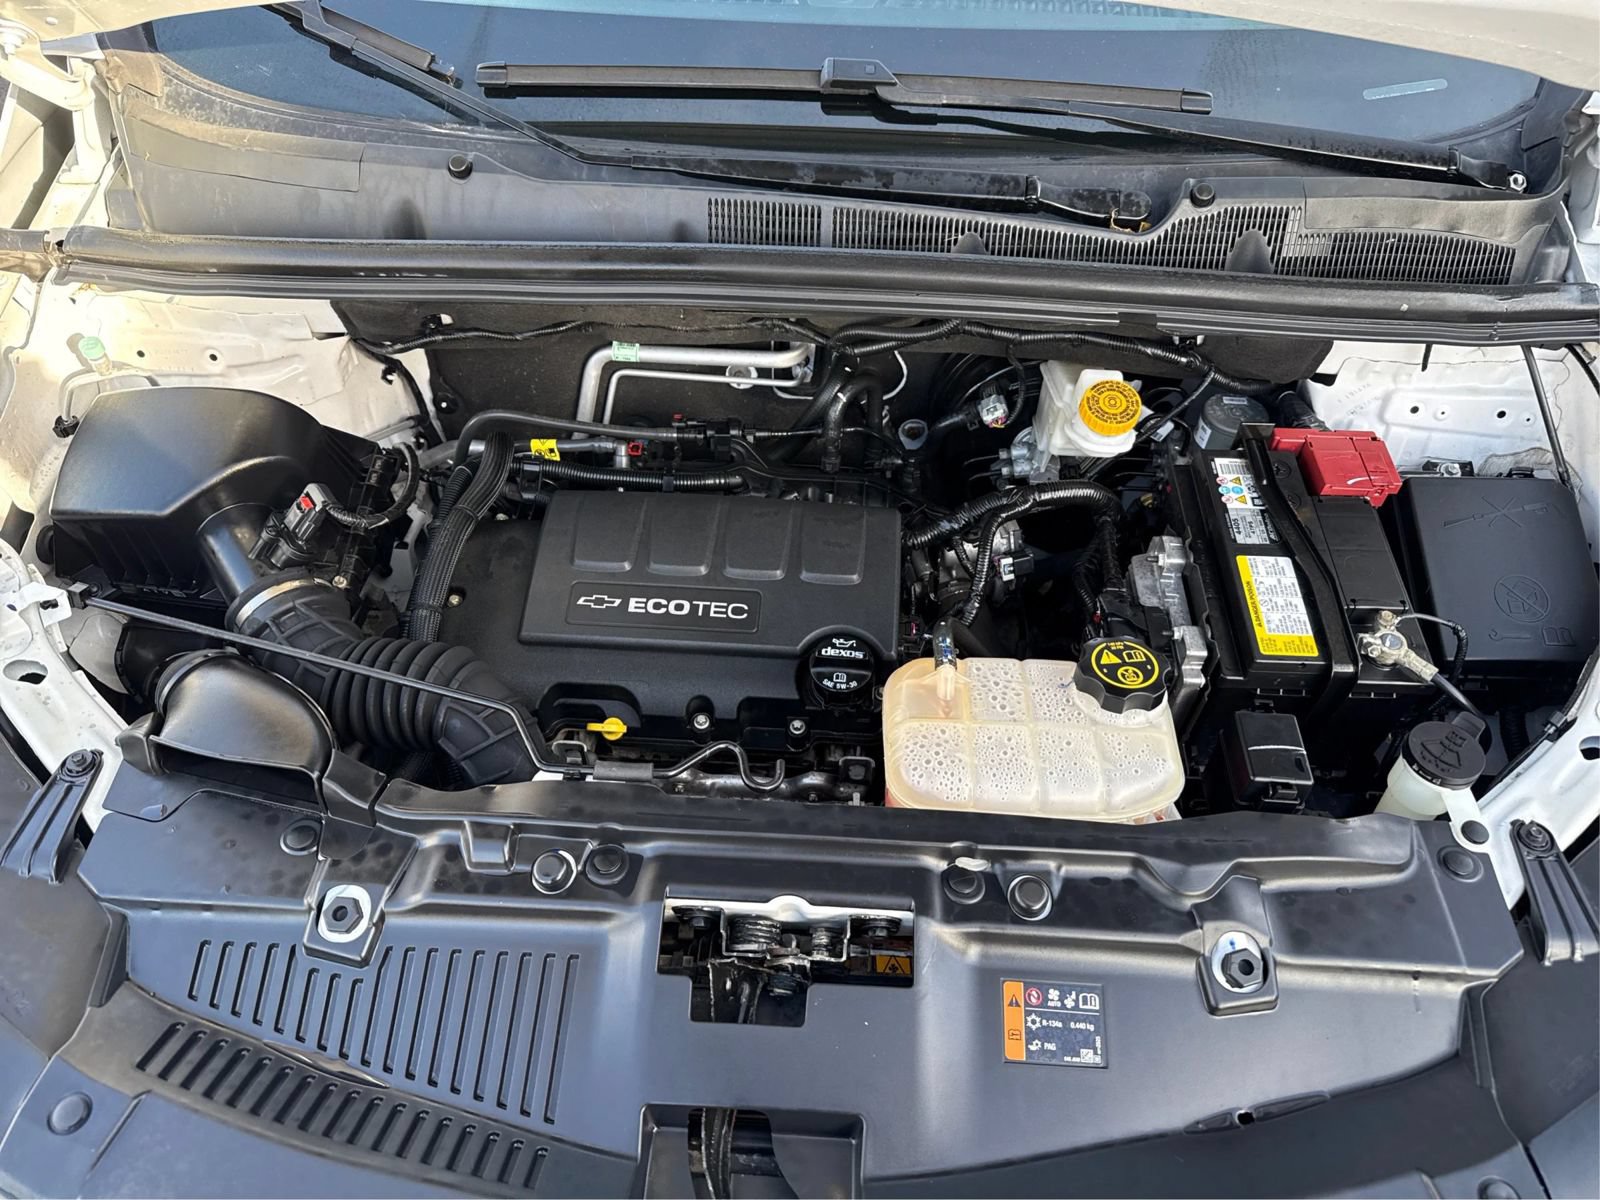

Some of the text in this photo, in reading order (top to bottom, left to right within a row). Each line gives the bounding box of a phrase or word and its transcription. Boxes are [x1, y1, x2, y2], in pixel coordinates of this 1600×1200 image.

[627, 596, 749, 620] ECOTEC
[821, 646, 864, 659] dexos
[822, 678, 858, 690] SAE 5W-30
[1041, 1019, 1063, 1028] R-134a
[1086, 1023, 1095, 1032] kg
[1043, 1042, 1057, 1051] PAG
